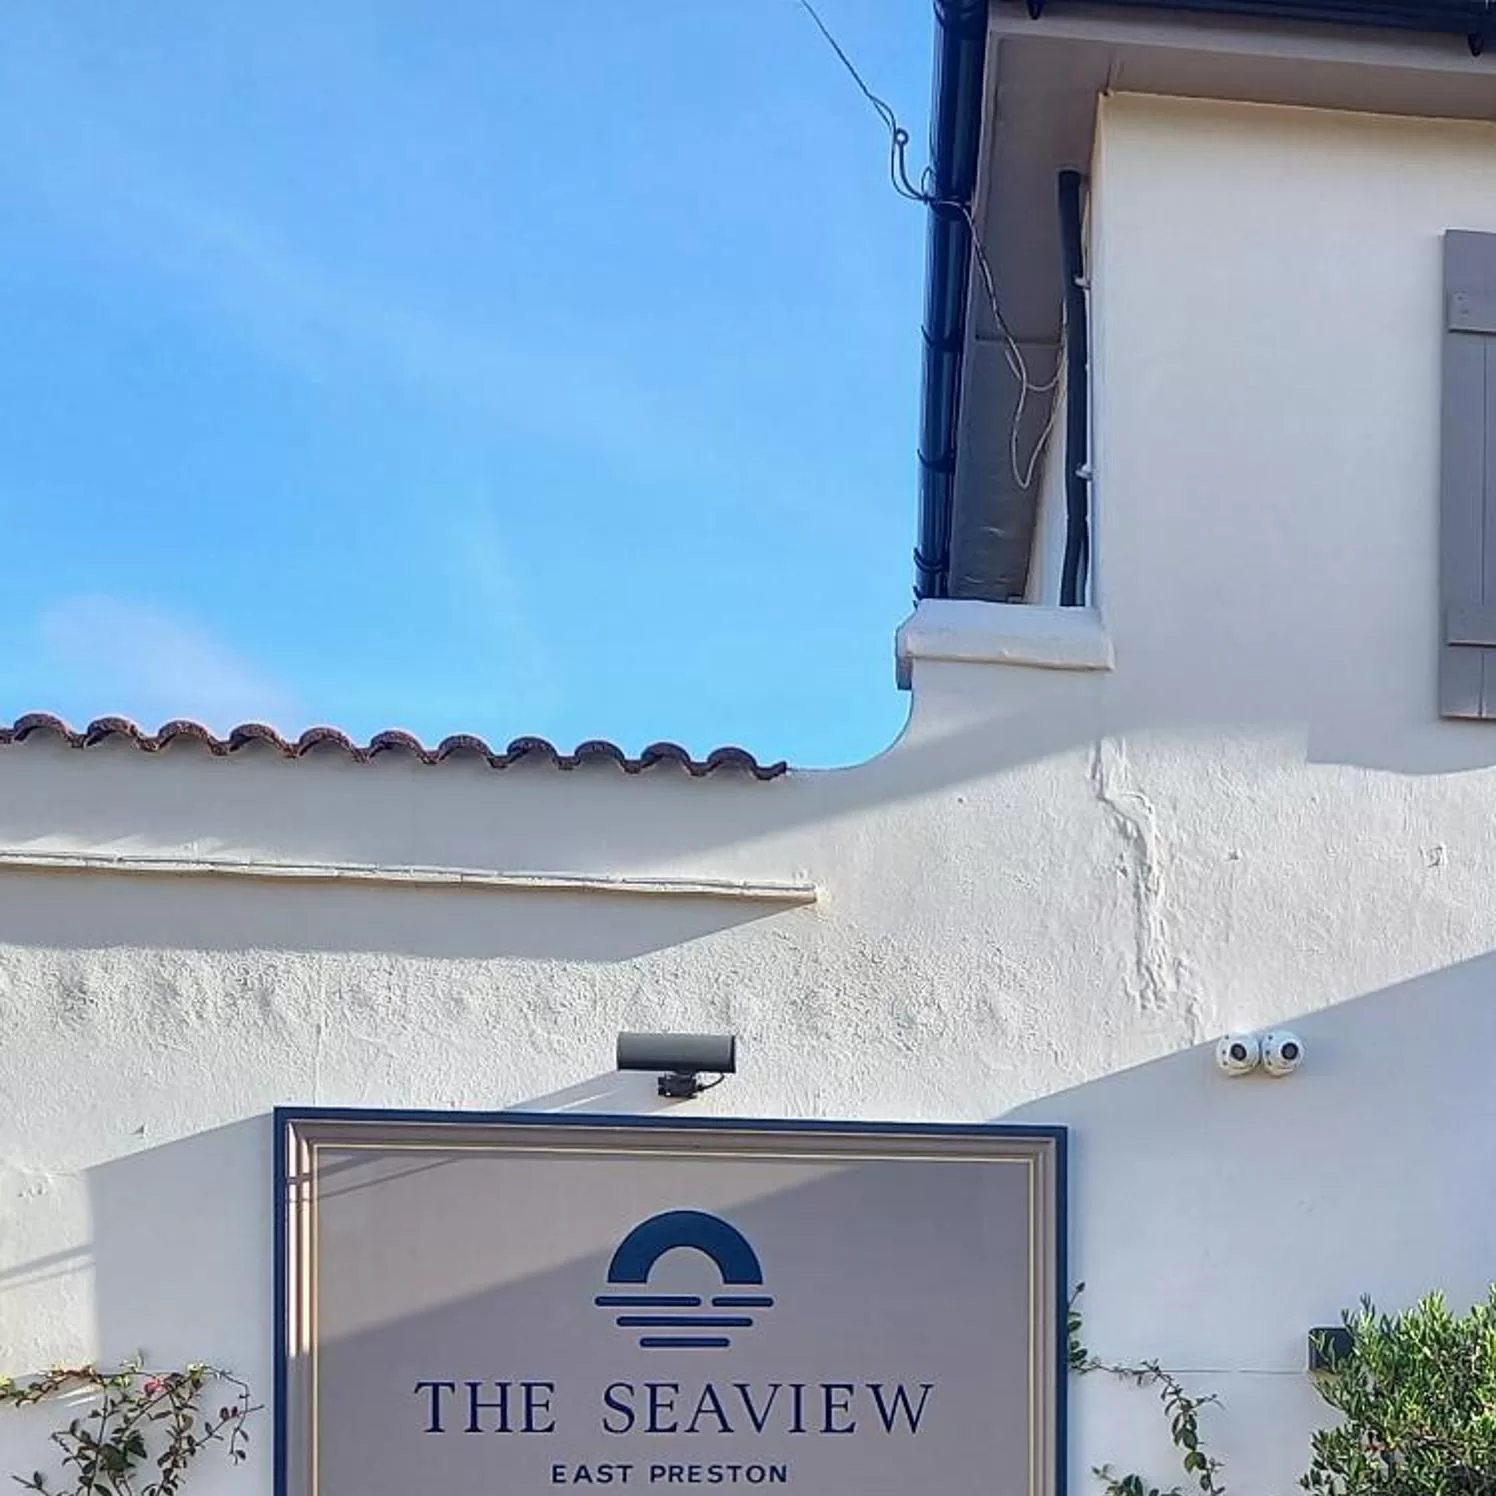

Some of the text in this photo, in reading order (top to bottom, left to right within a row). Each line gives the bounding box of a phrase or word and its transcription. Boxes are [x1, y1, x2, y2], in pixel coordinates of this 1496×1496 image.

[414, 1381, 934, 1435] THE SEAVIEW
[552, 1464, 787, 1484] EAST PRESTON
